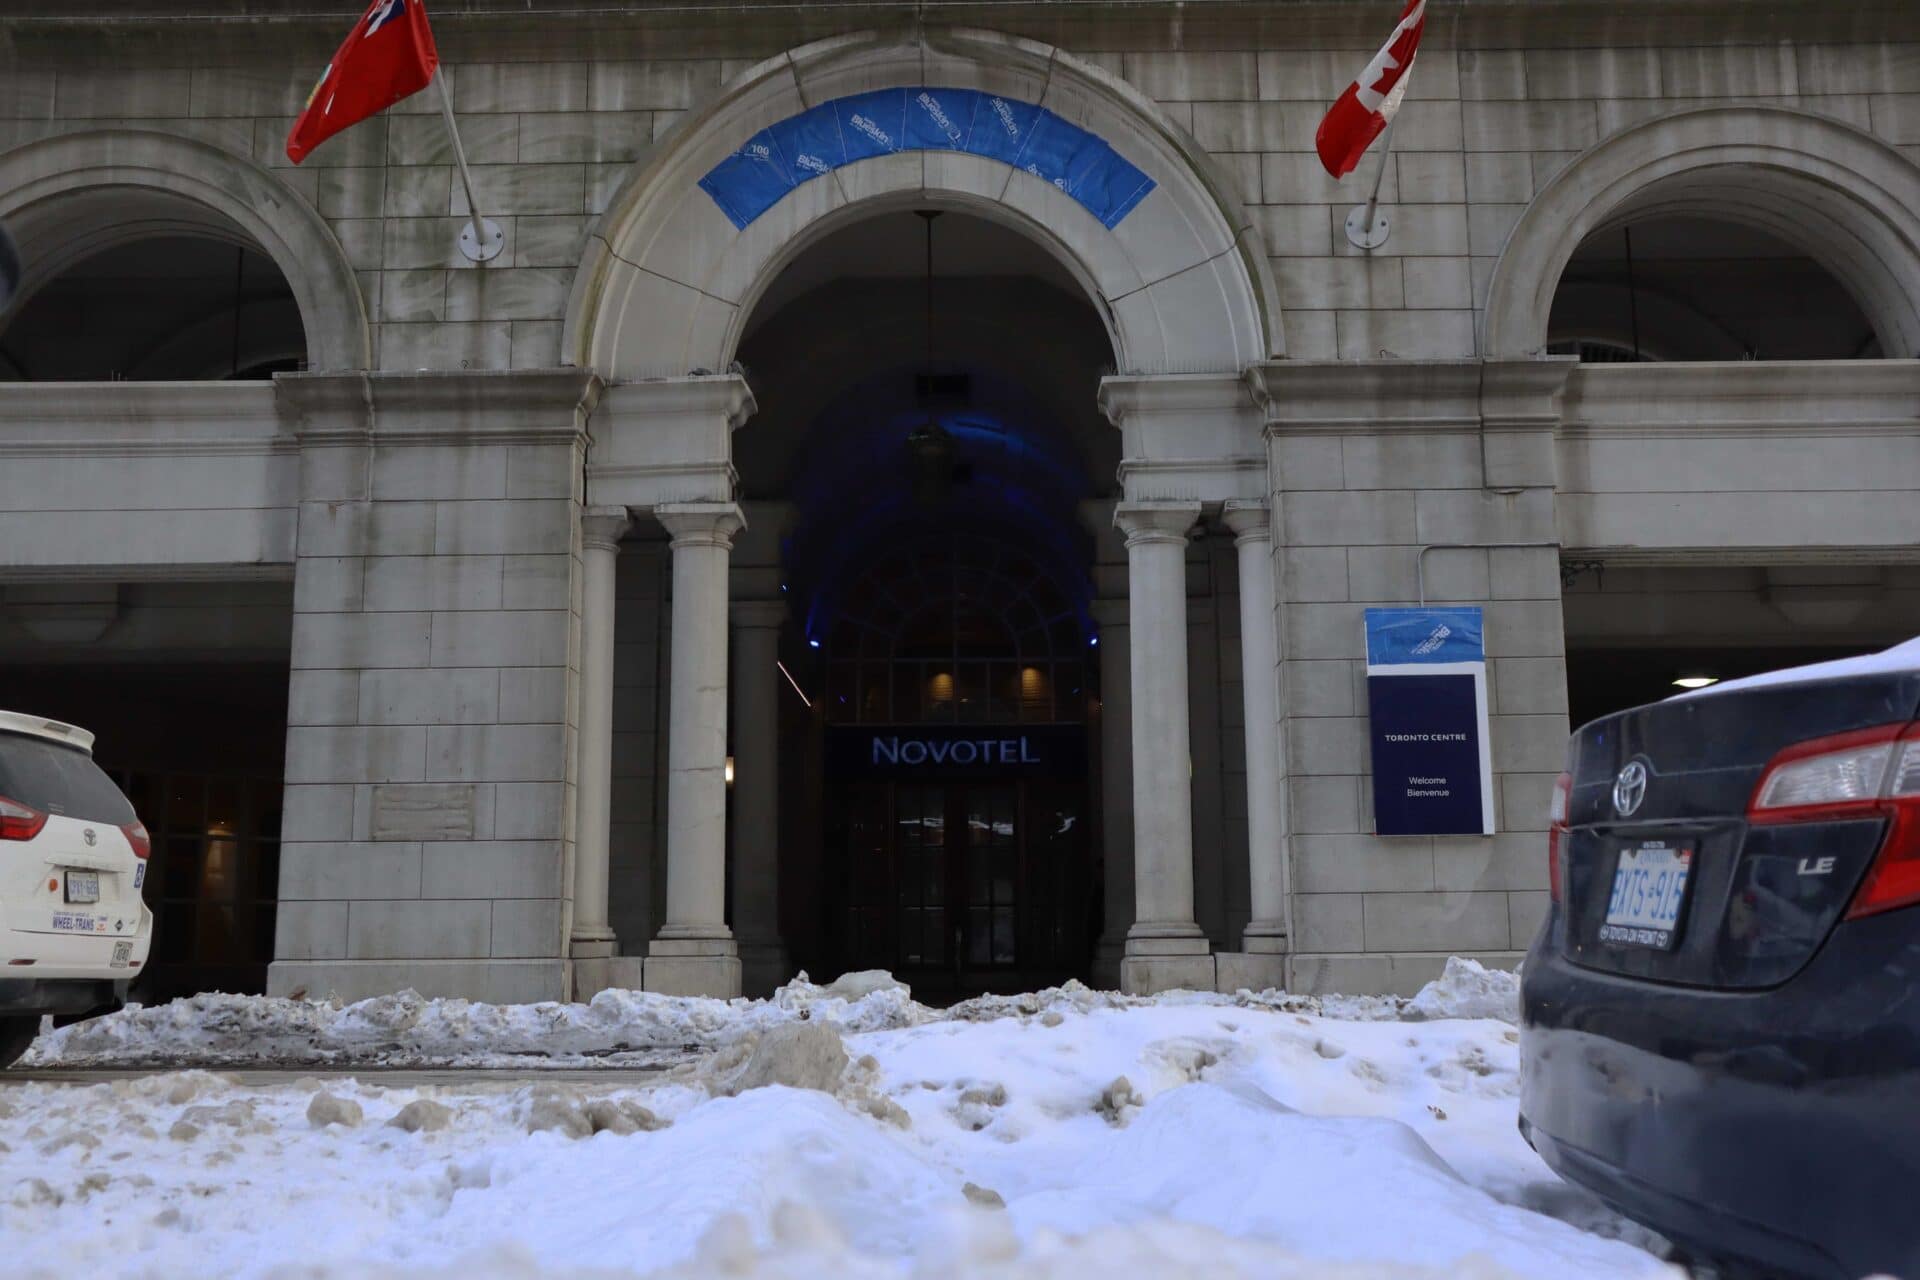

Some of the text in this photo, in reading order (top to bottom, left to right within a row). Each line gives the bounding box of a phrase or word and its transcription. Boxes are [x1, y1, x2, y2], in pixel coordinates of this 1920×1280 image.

[1384, 733, 1466, 742] TORONTO CENTRE
[872, 736, 1041, 764] NOVOTEL
[1408, 776, 1447, 785] Welcome
[1407, 788, 1450, 797] Bienvenue
[1797, 856, 1837, 875] LE
